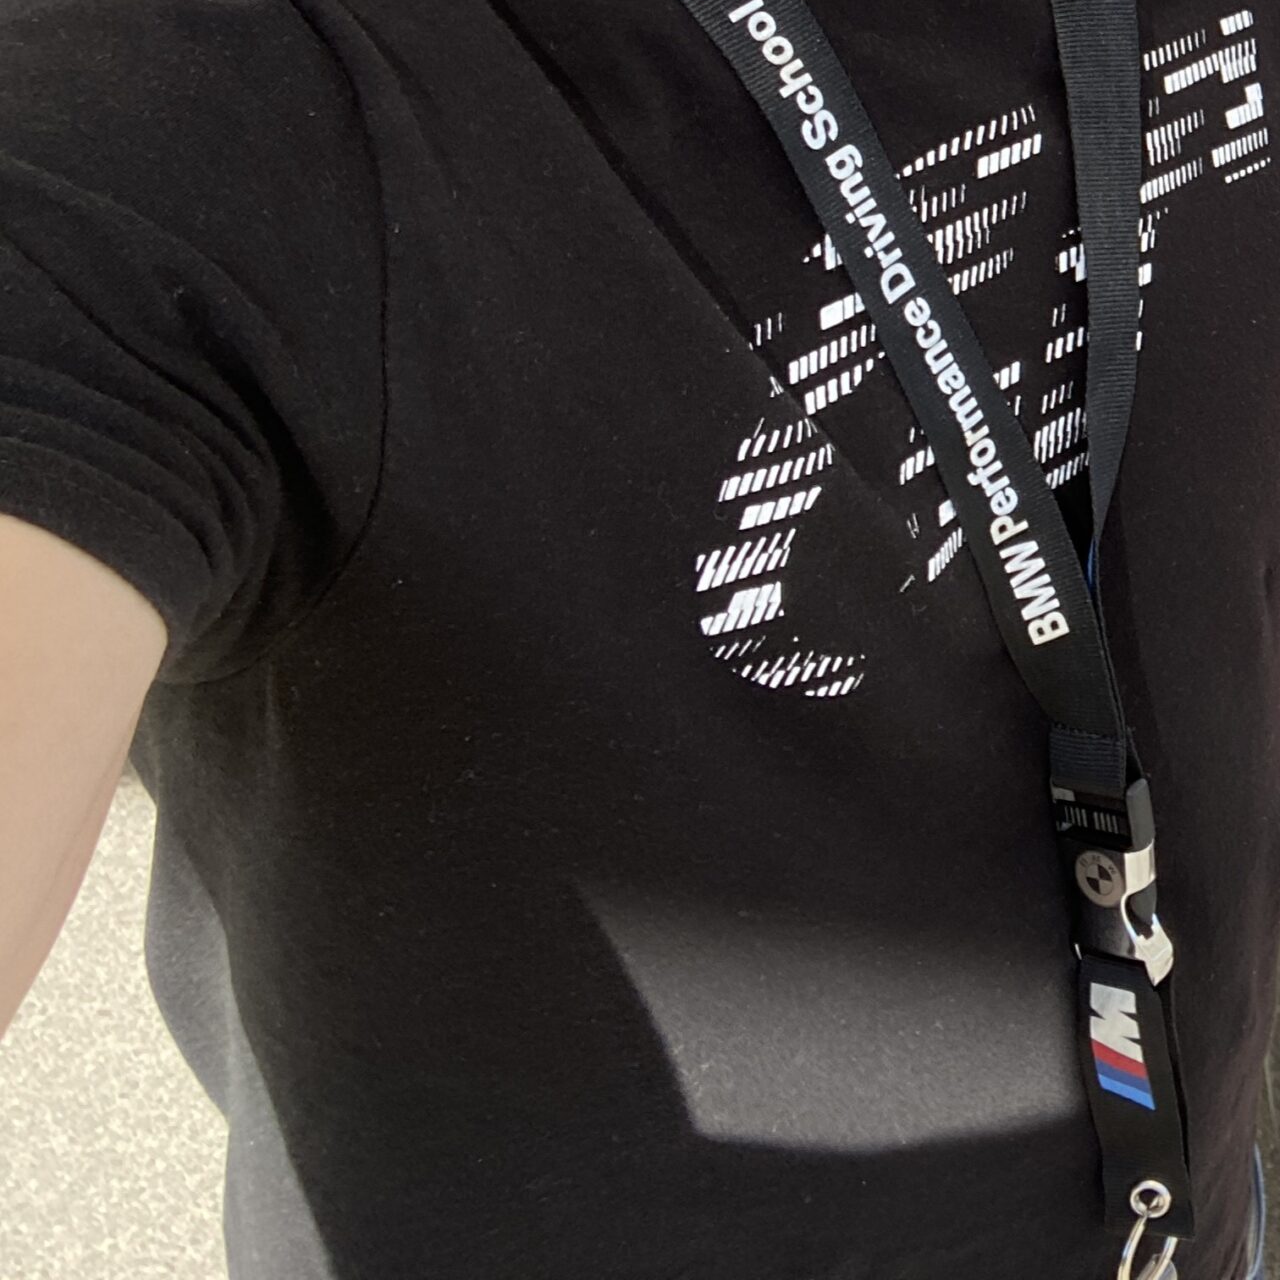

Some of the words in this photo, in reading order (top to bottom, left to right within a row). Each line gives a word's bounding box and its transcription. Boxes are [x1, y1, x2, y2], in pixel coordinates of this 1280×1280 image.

[824, 143, 916, 305] Driving
[903, 296, 1030, 546] Performance
[998, 540, 1070, 646] BMW
